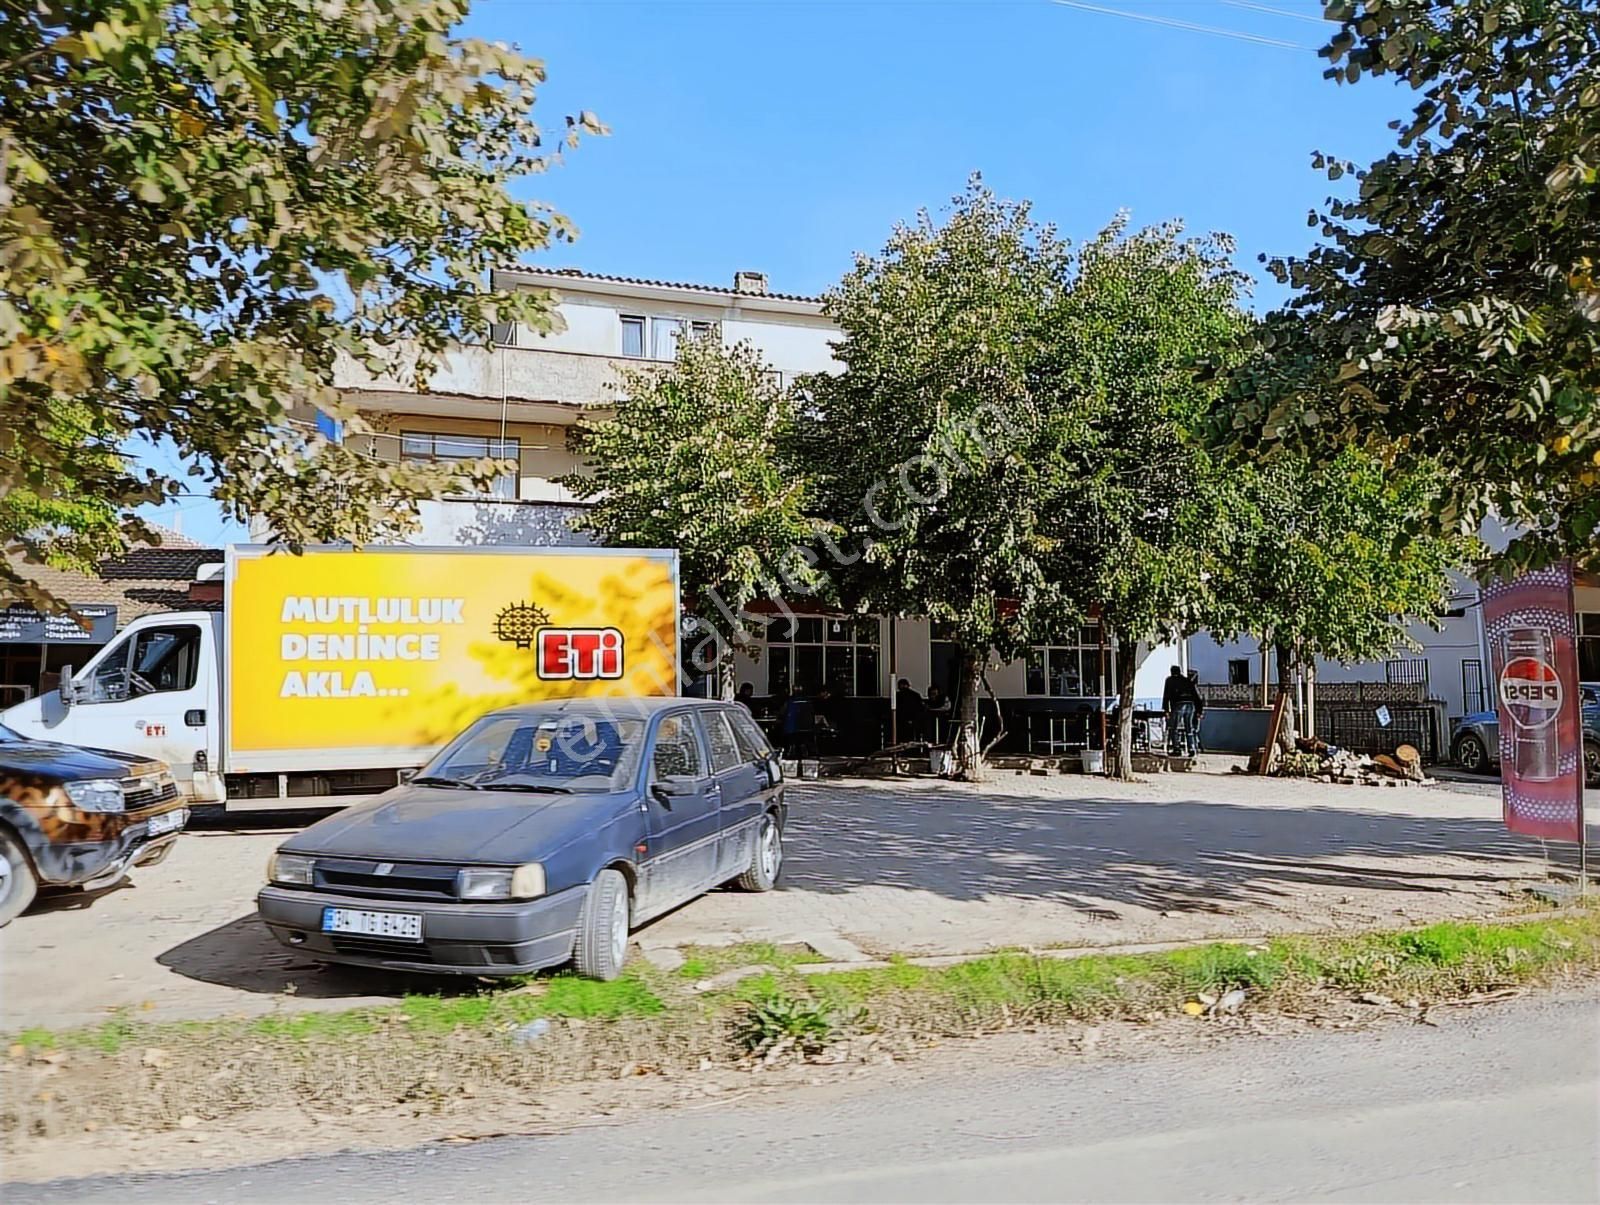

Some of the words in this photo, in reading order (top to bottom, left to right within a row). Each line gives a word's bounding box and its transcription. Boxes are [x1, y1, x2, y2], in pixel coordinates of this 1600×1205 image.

[281, 597, 465, 624] MUTLULUK
[281, 625, 441, 660] DENİNCE
[279, 671, 409, 697] AKLA...
